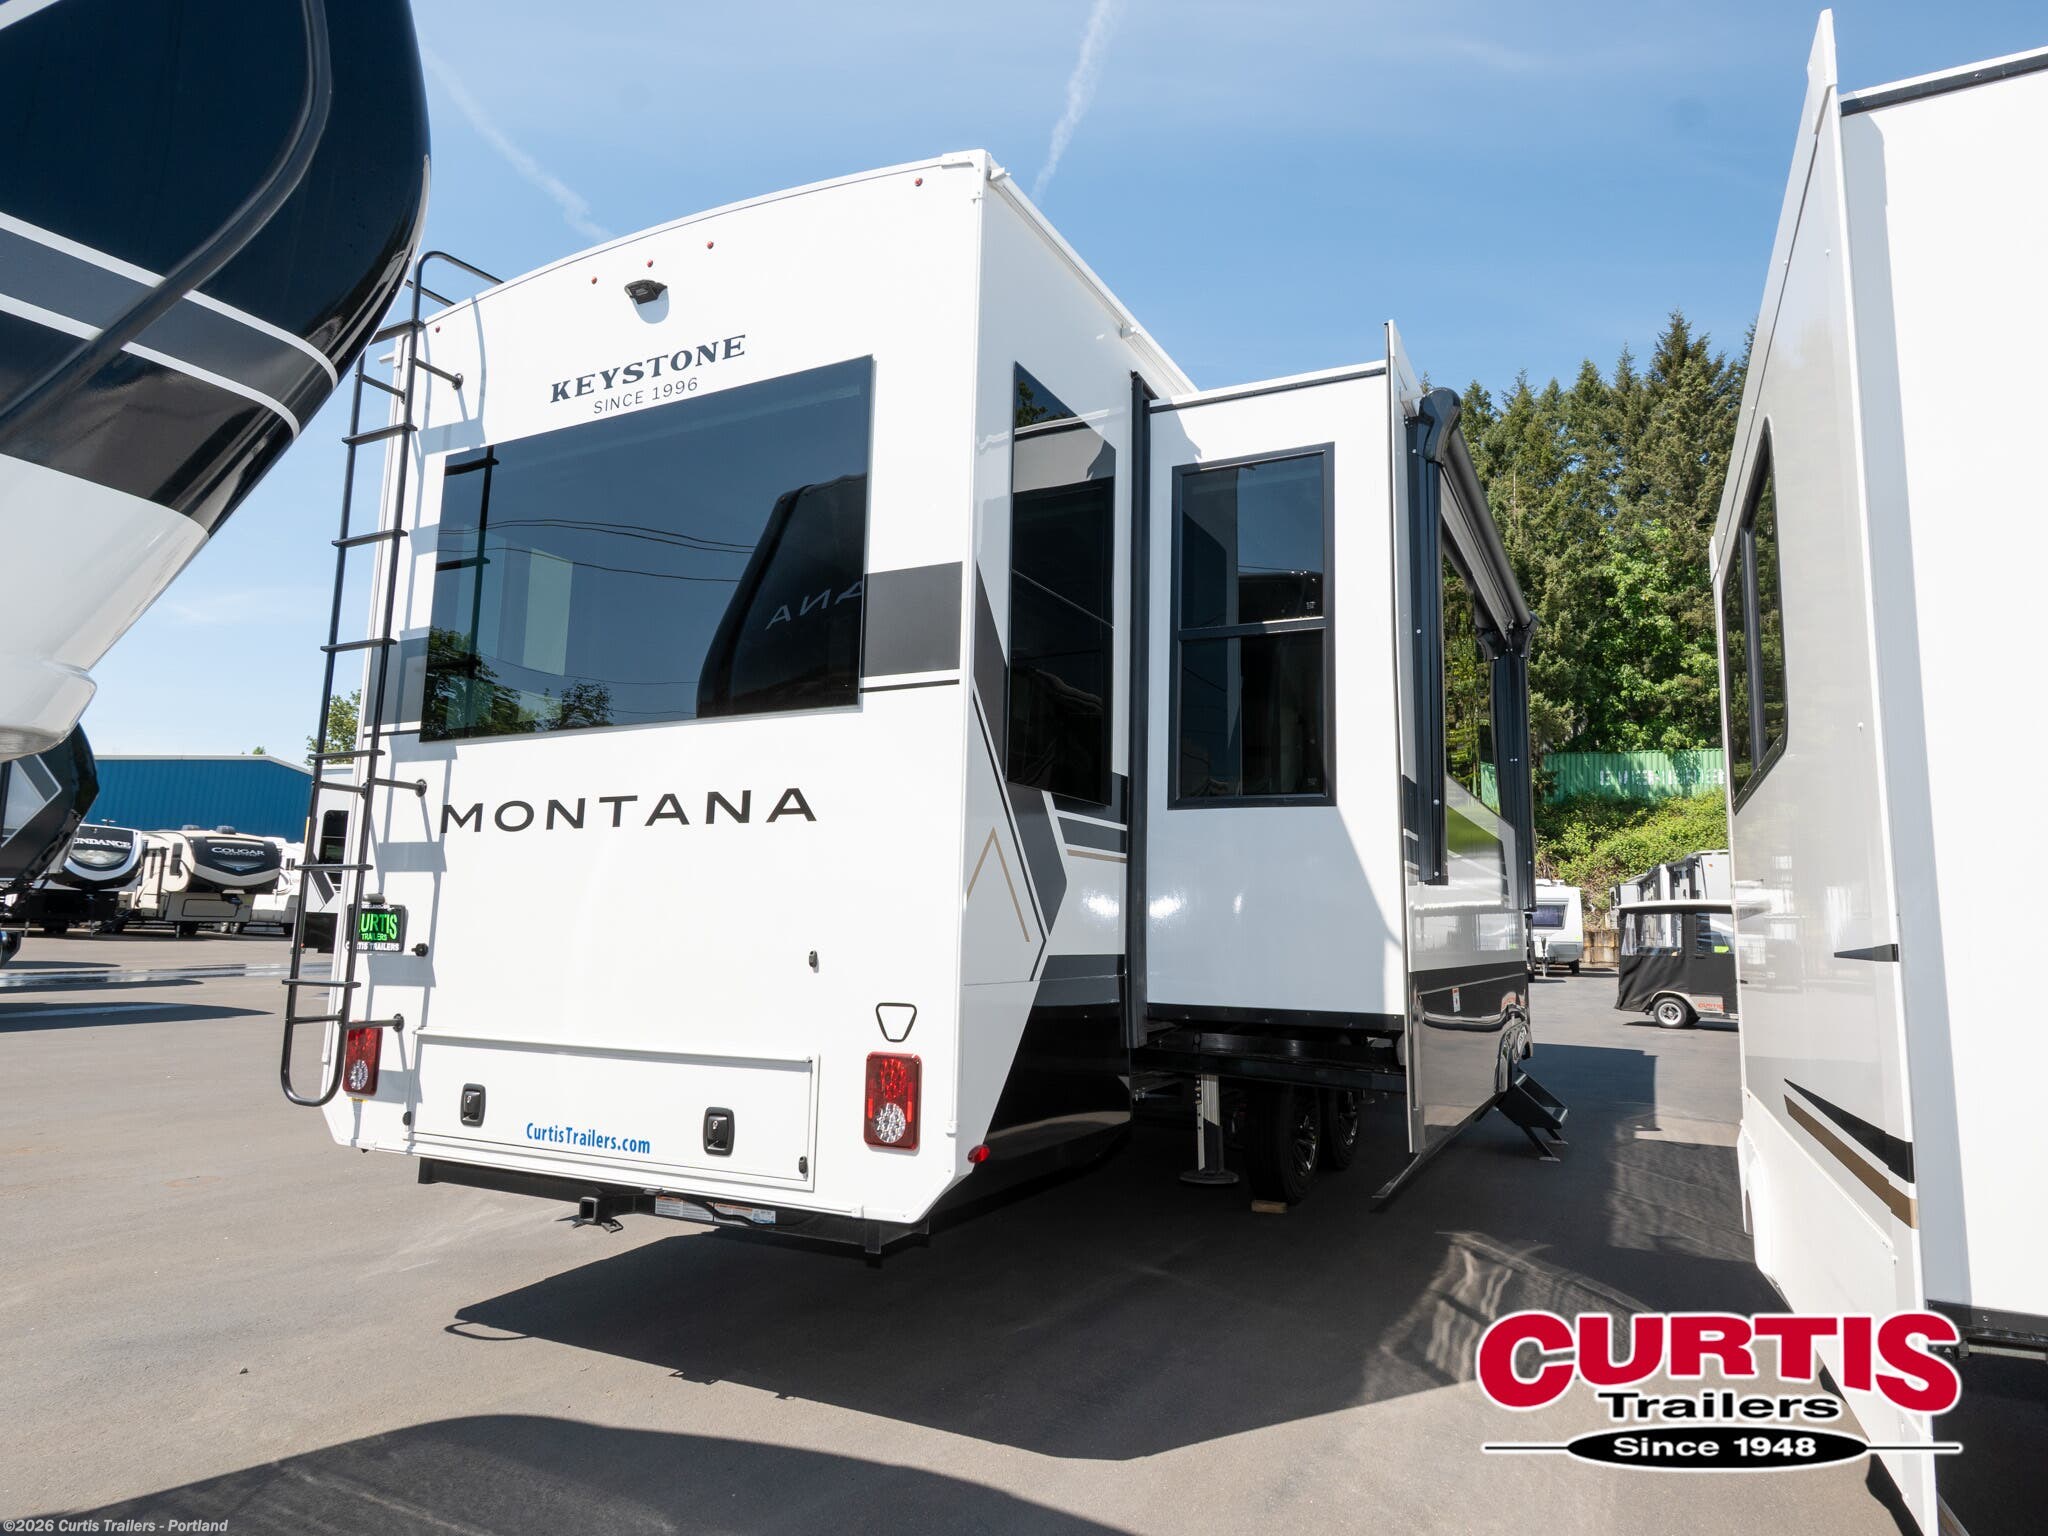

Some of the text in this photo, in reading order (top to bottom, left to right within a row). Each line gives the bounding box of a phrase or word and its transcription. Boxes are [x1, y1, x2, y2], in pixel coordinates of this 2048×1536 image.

[550, 334, 746, 404] KEYSTONE
[593, 377, 698, 414] SINCE 1996
[440, 788, 817, 834] MONTANA
[72, 837, 132, 849] UNDANCE
[211, 846, 265, 857] COUGAR
[359, 913, 398, 940] URTIS
[526, 1122, 651, 1155] CurtisTrailers.com
